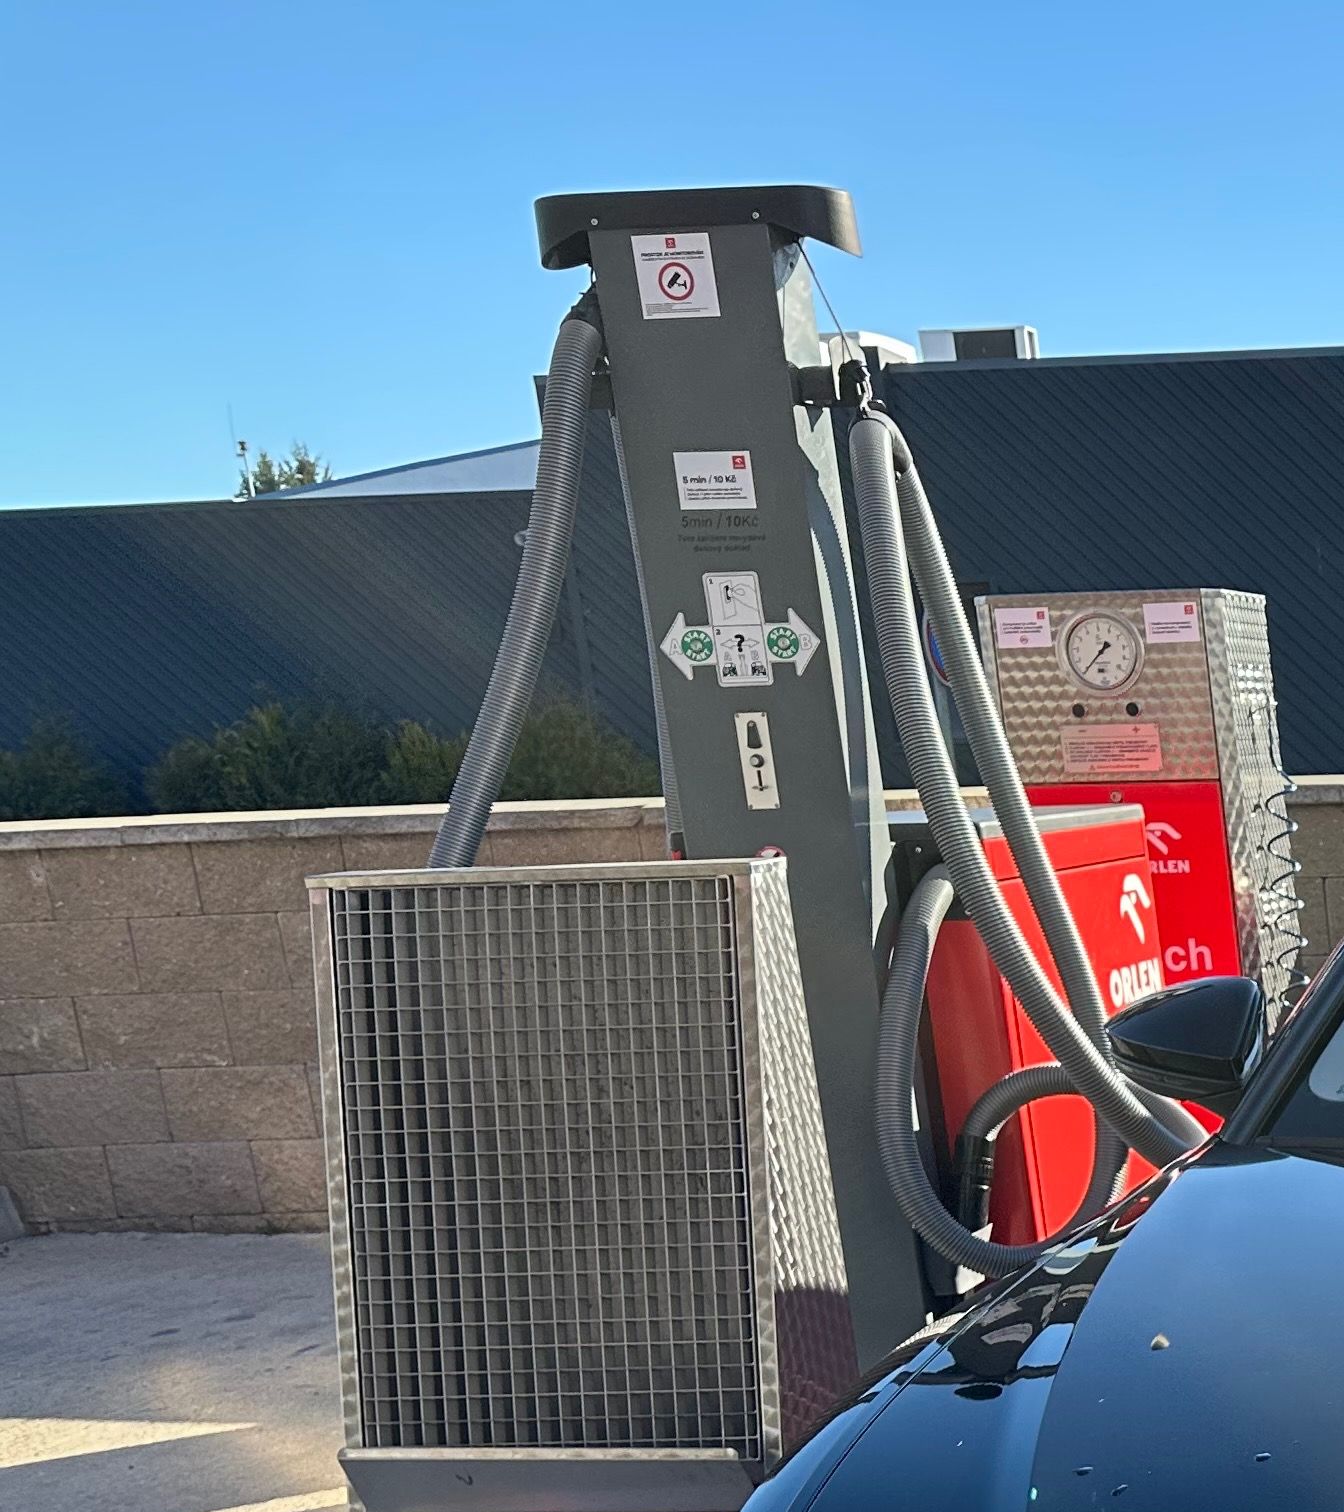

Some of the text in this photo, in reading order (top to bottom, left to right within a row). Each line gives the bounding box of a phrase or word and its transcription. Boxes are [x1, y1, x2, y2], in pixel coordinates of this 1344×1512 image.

[690, 475, 707, 484] min
[714, 475, 724, 483] 10
[681, 515, 713, 528] 5min
[684, 631, 711, 643] START
[770, 628, 796, 640] START
[668, 638, 683, 656] A
[799, 633, 812, 651] B
[1151, 859, 1190, 873] RLEN
[1109, 957, 1164, 1008] ORLEN
